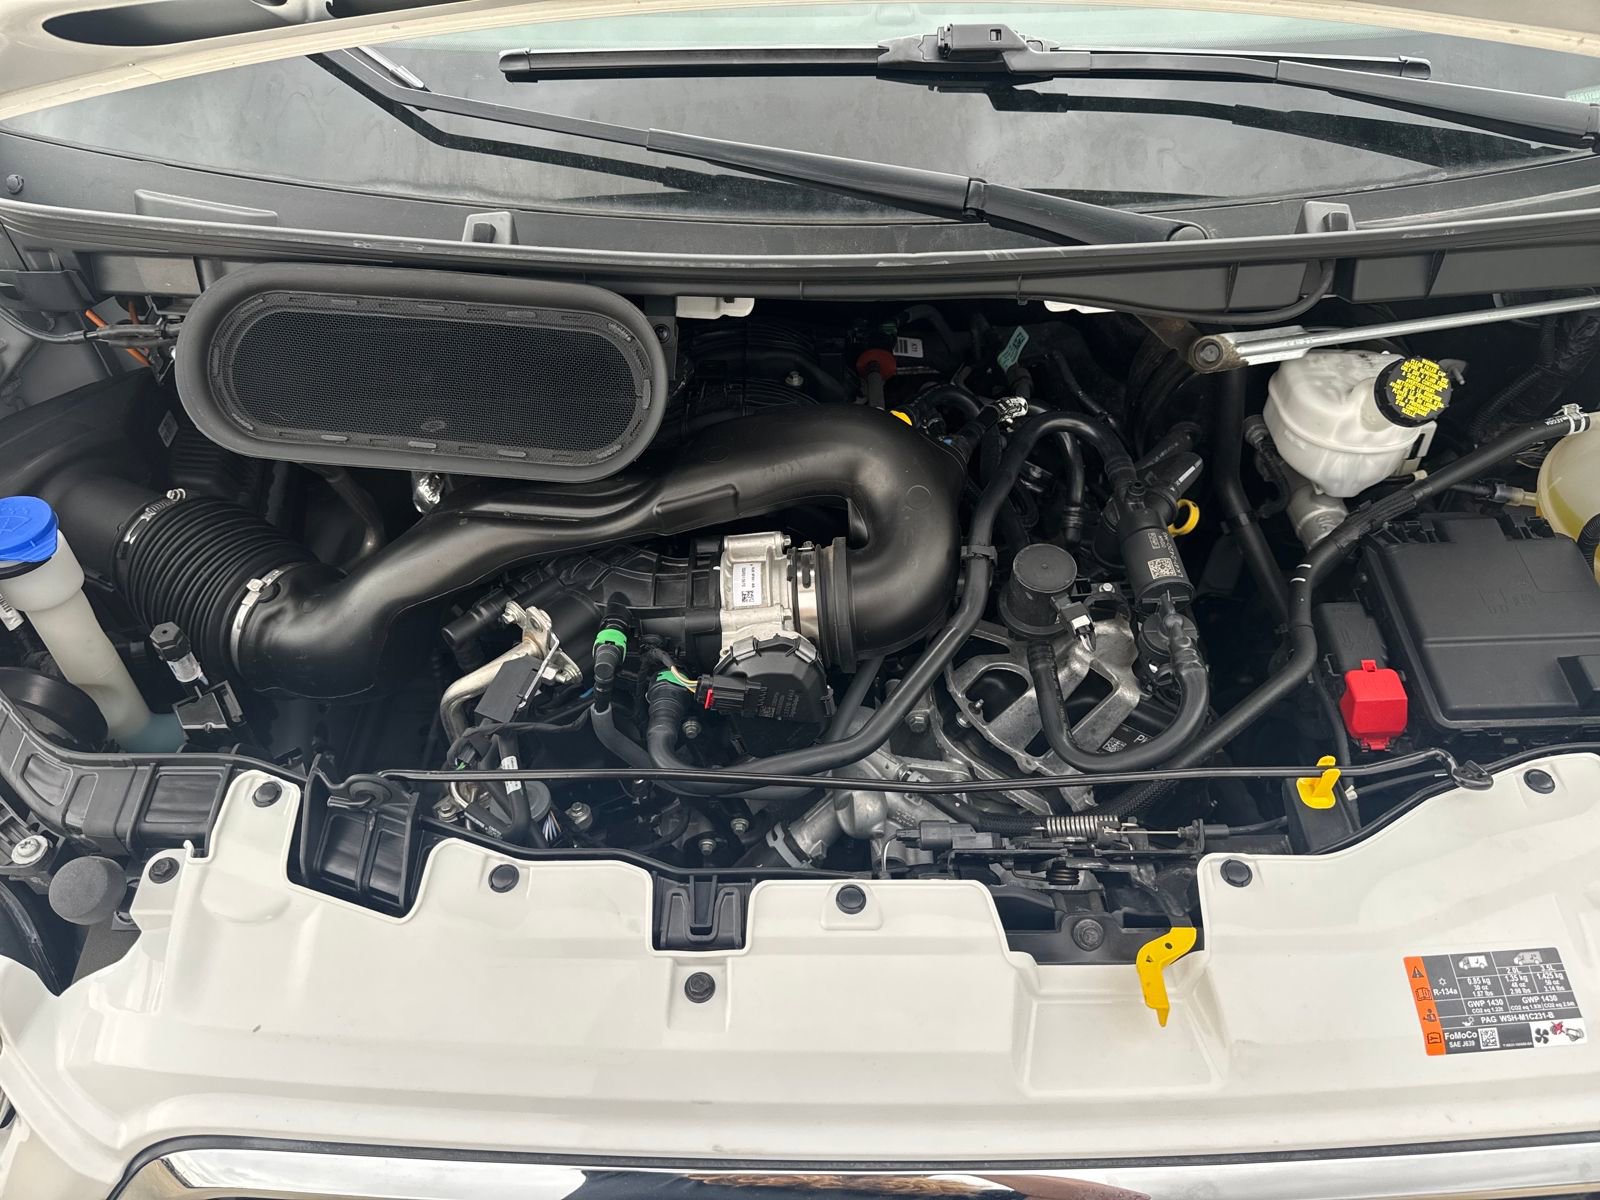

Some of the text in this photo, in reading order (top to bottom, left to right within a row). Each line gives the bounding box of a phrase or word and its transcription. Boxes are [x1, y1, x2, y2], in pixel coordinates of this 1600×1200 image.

[1519, 974, 1528, 982] kg
[1554, 972, 1563, 980] kg
[1433, 987, 1458, 995] R-134a
[1468, 1000, 1485, 1008] GWP
[1522, 996, 1539, 1004] GWP
[1481, 1012, 1554, 1024] PAG WSH-M1C231-B
[1444, 1031, 1477, 1040] FoMoCo
